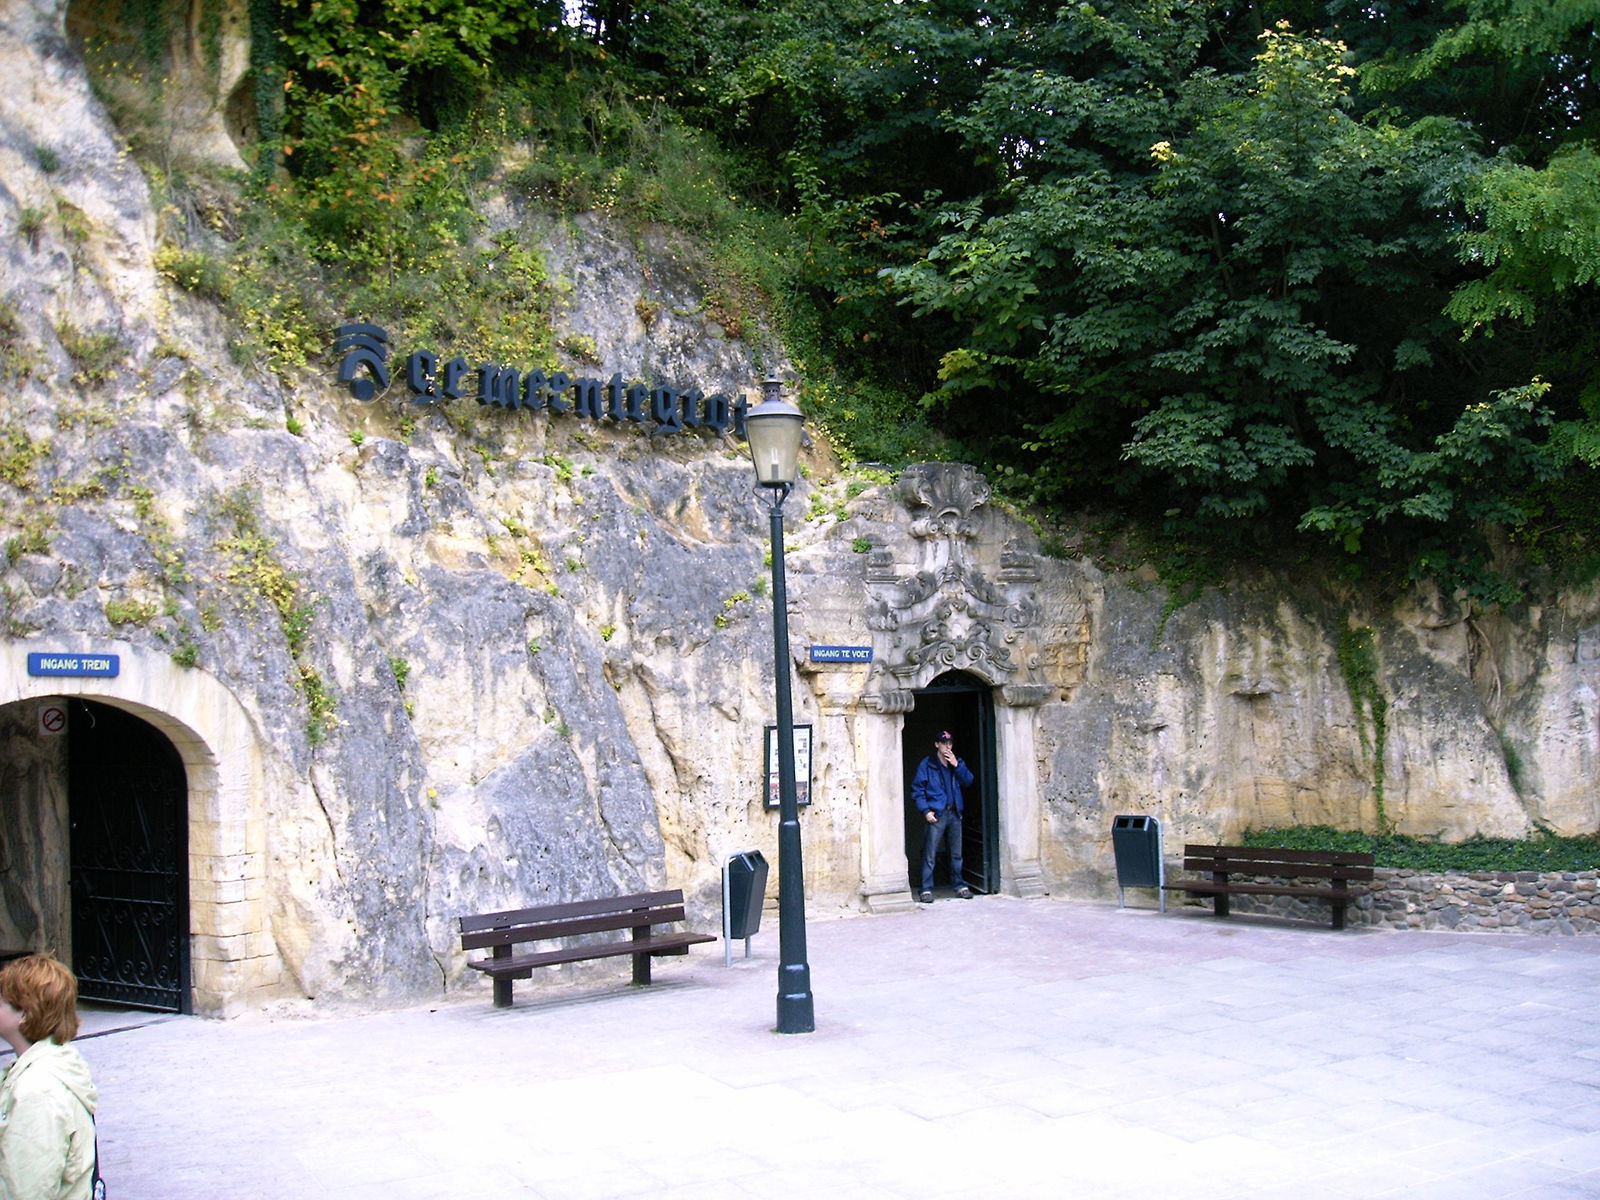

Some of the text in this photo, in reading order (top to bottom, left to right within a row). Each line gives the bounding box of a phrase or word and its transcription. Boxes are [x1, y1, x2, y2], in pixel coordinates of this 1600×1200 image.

[813, 650, 870, 658] INGANG TE VOET
[40, 658, 110, 670] INGANG TREIN
